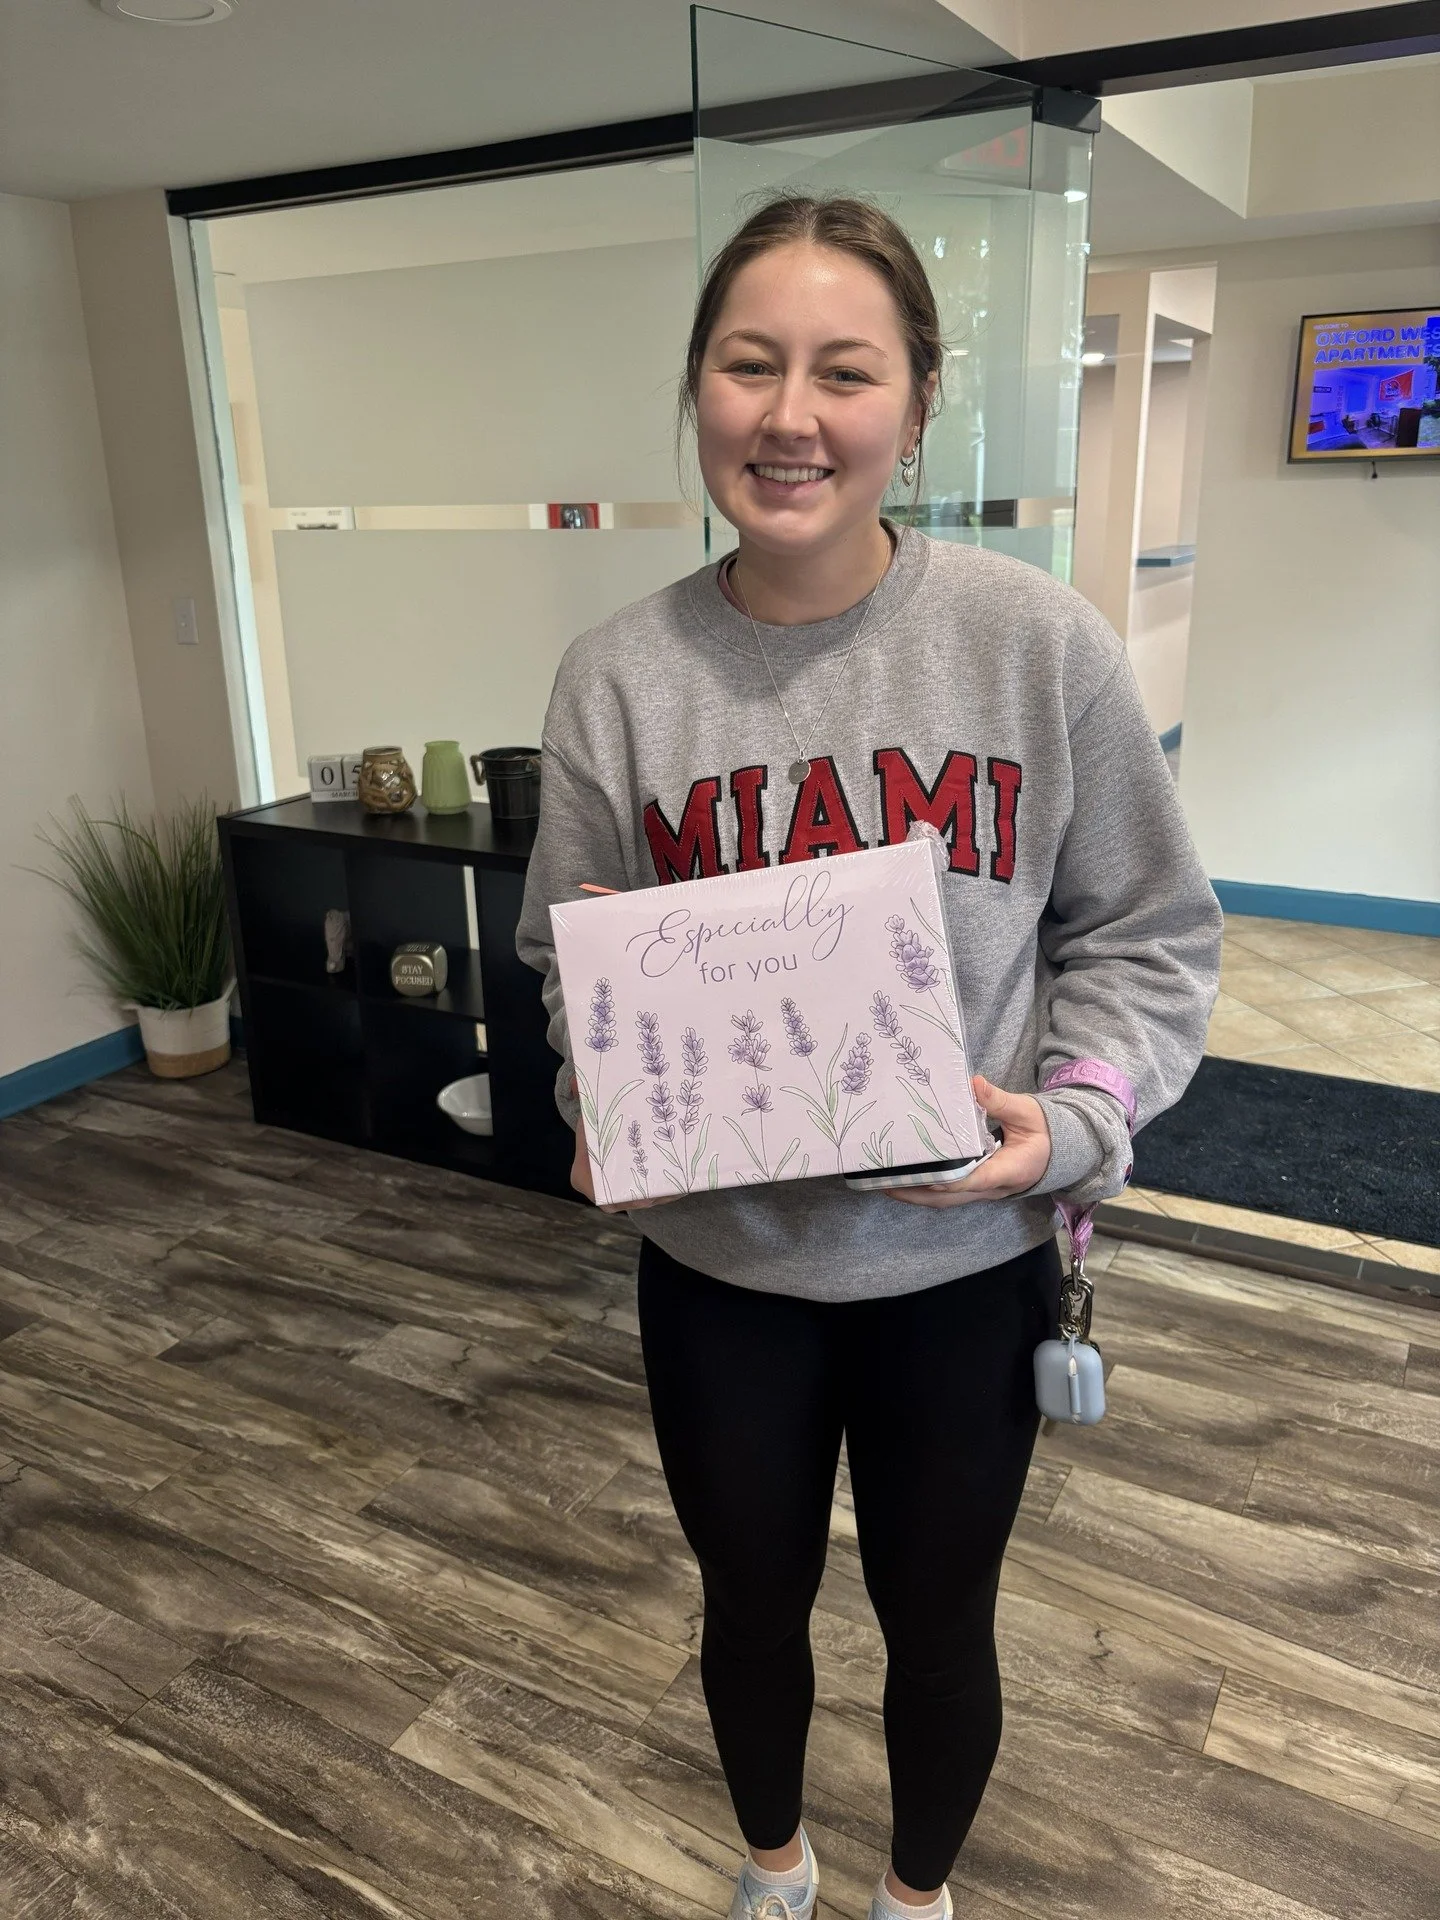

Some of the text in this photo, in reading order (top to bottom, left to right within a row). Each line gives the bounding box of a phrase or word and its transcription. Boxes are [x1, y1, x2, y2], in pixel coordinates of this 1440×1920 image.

[1316, 328, 1396, 346] OXFORD
[643, 747, 1023, 884] MIAMI
[625, 870, 855, 978] Especially
[395, 976, 433, 986] FOCUSED
[401, 964, 423, 975] STAY
[699, 953, 799, 985] for you
